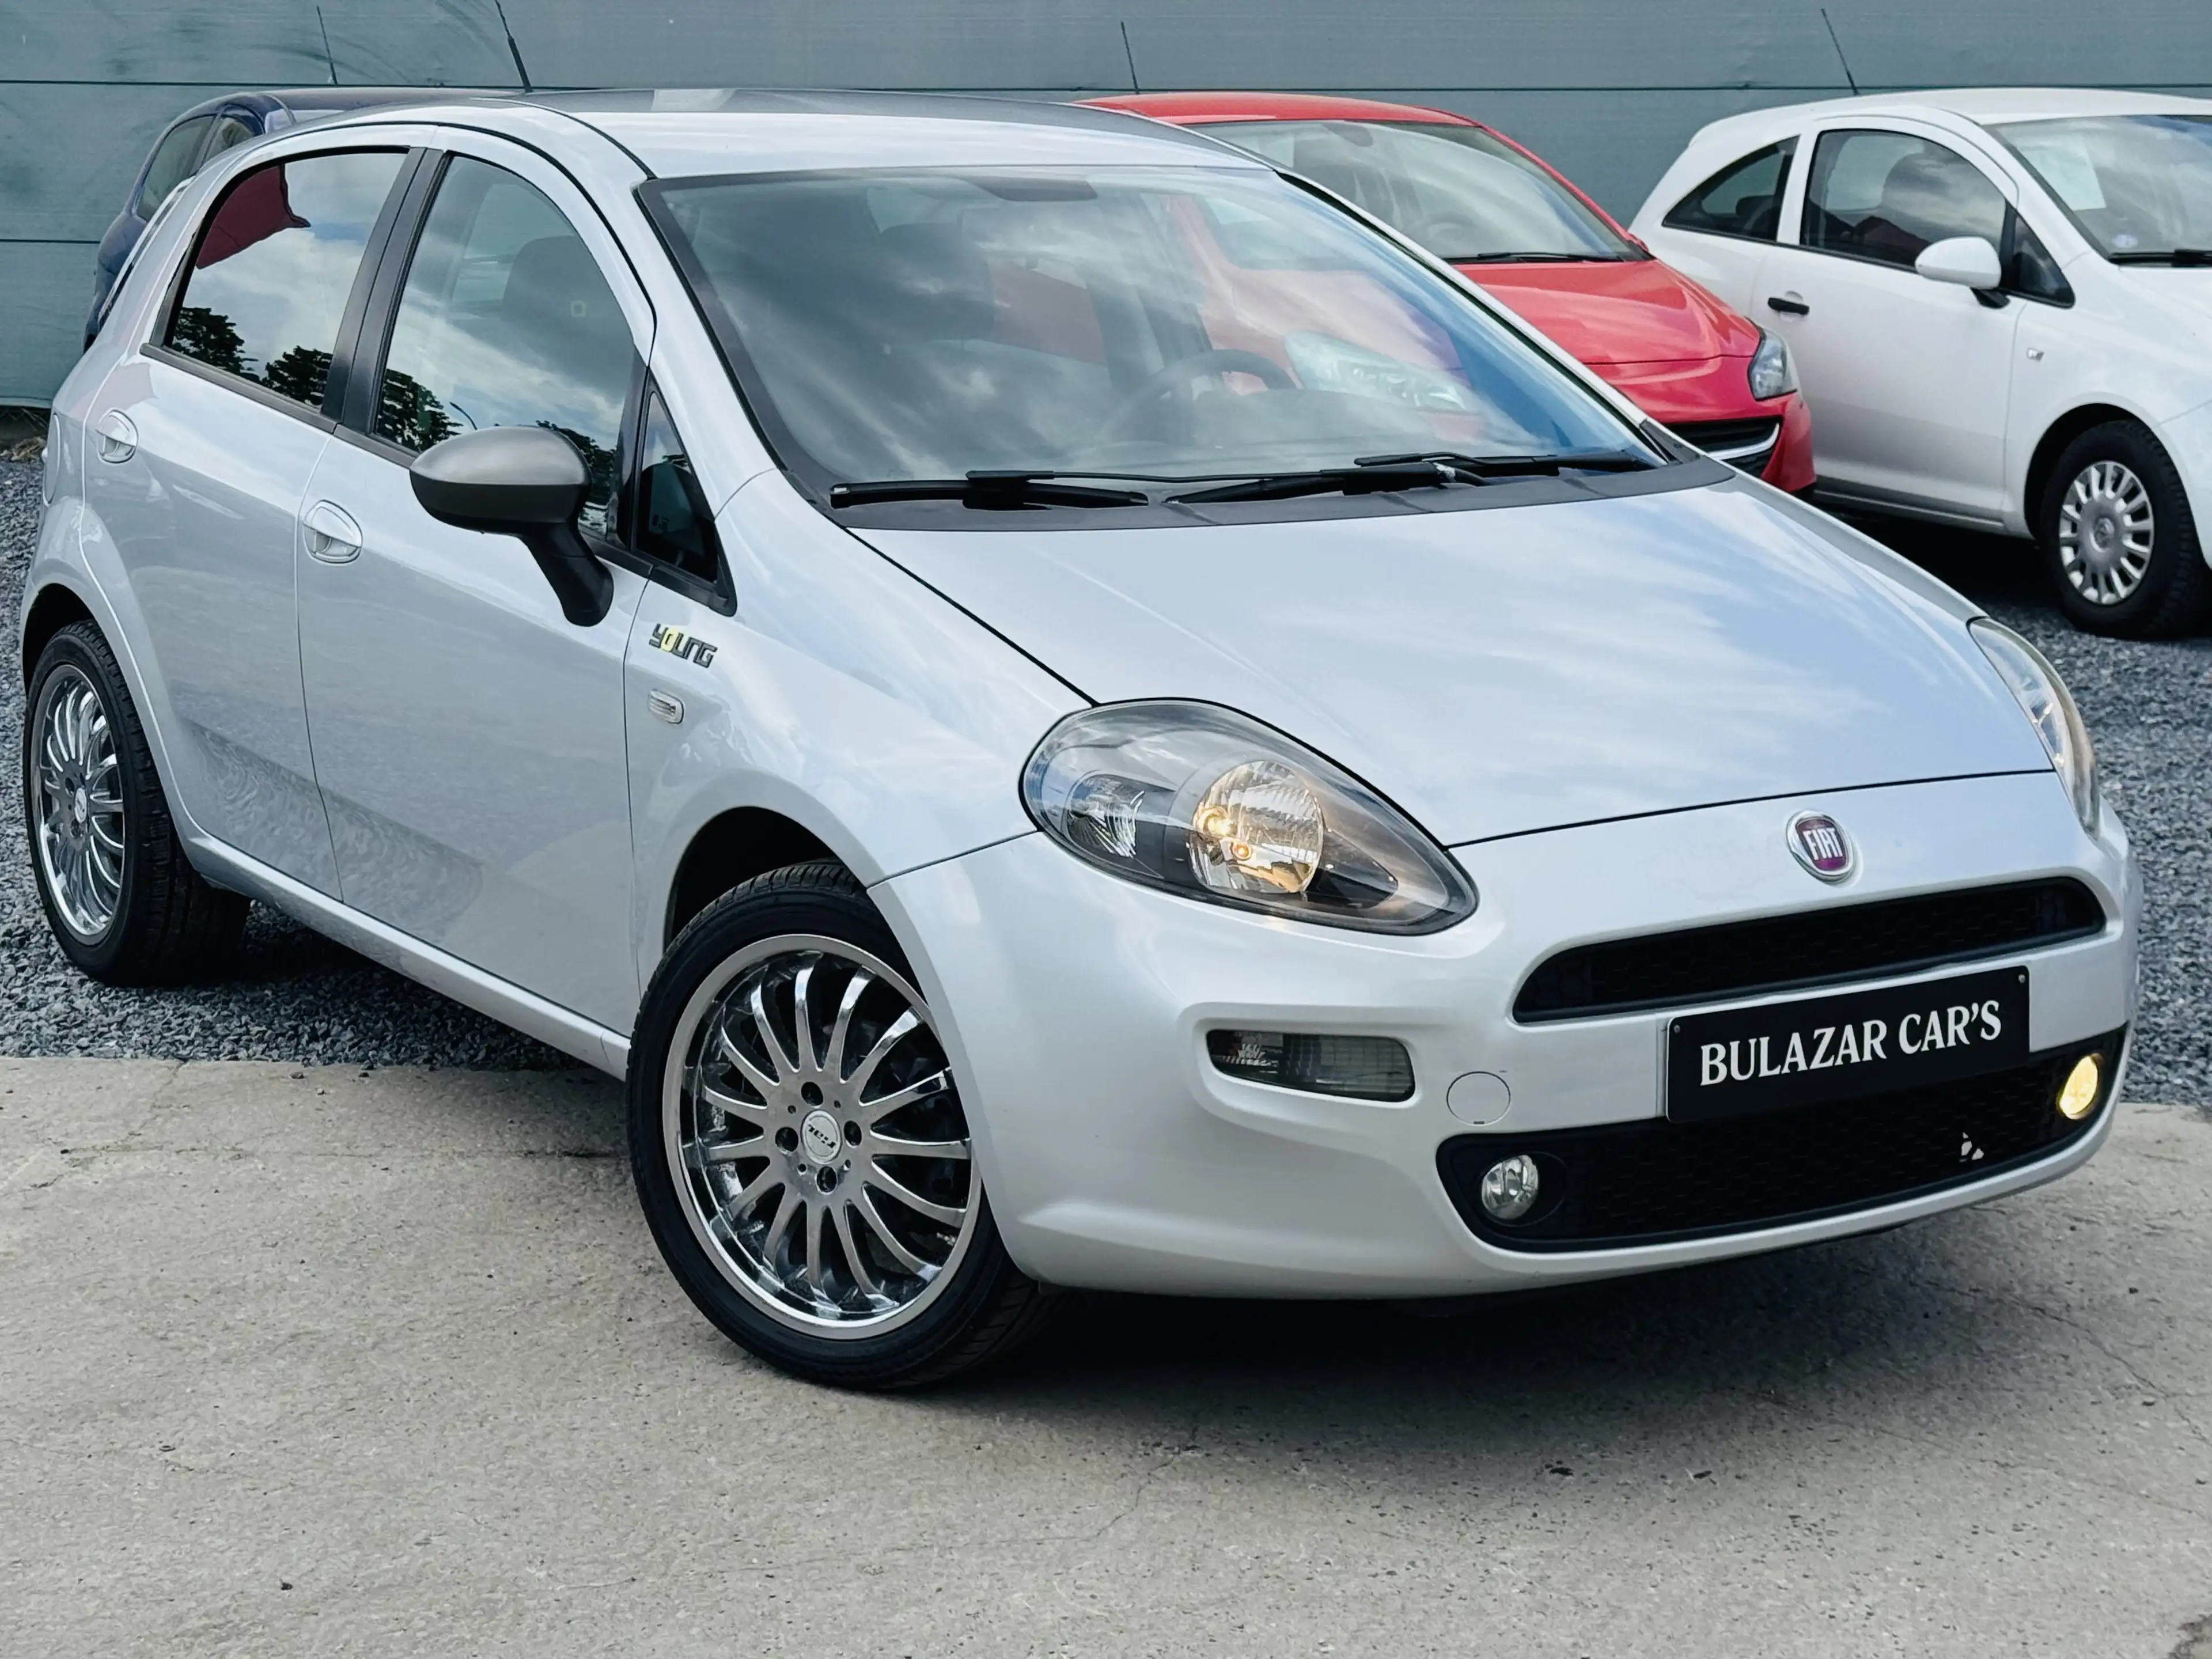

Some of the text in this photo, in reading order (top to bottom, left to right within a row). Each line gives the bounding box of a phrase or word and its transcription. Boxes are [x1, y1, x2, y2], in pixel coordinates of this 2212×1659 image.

[1802, 827, 1844, 861] FIAT
[1700, 1000, 2002, 1086] BULAZAR CAR'S
